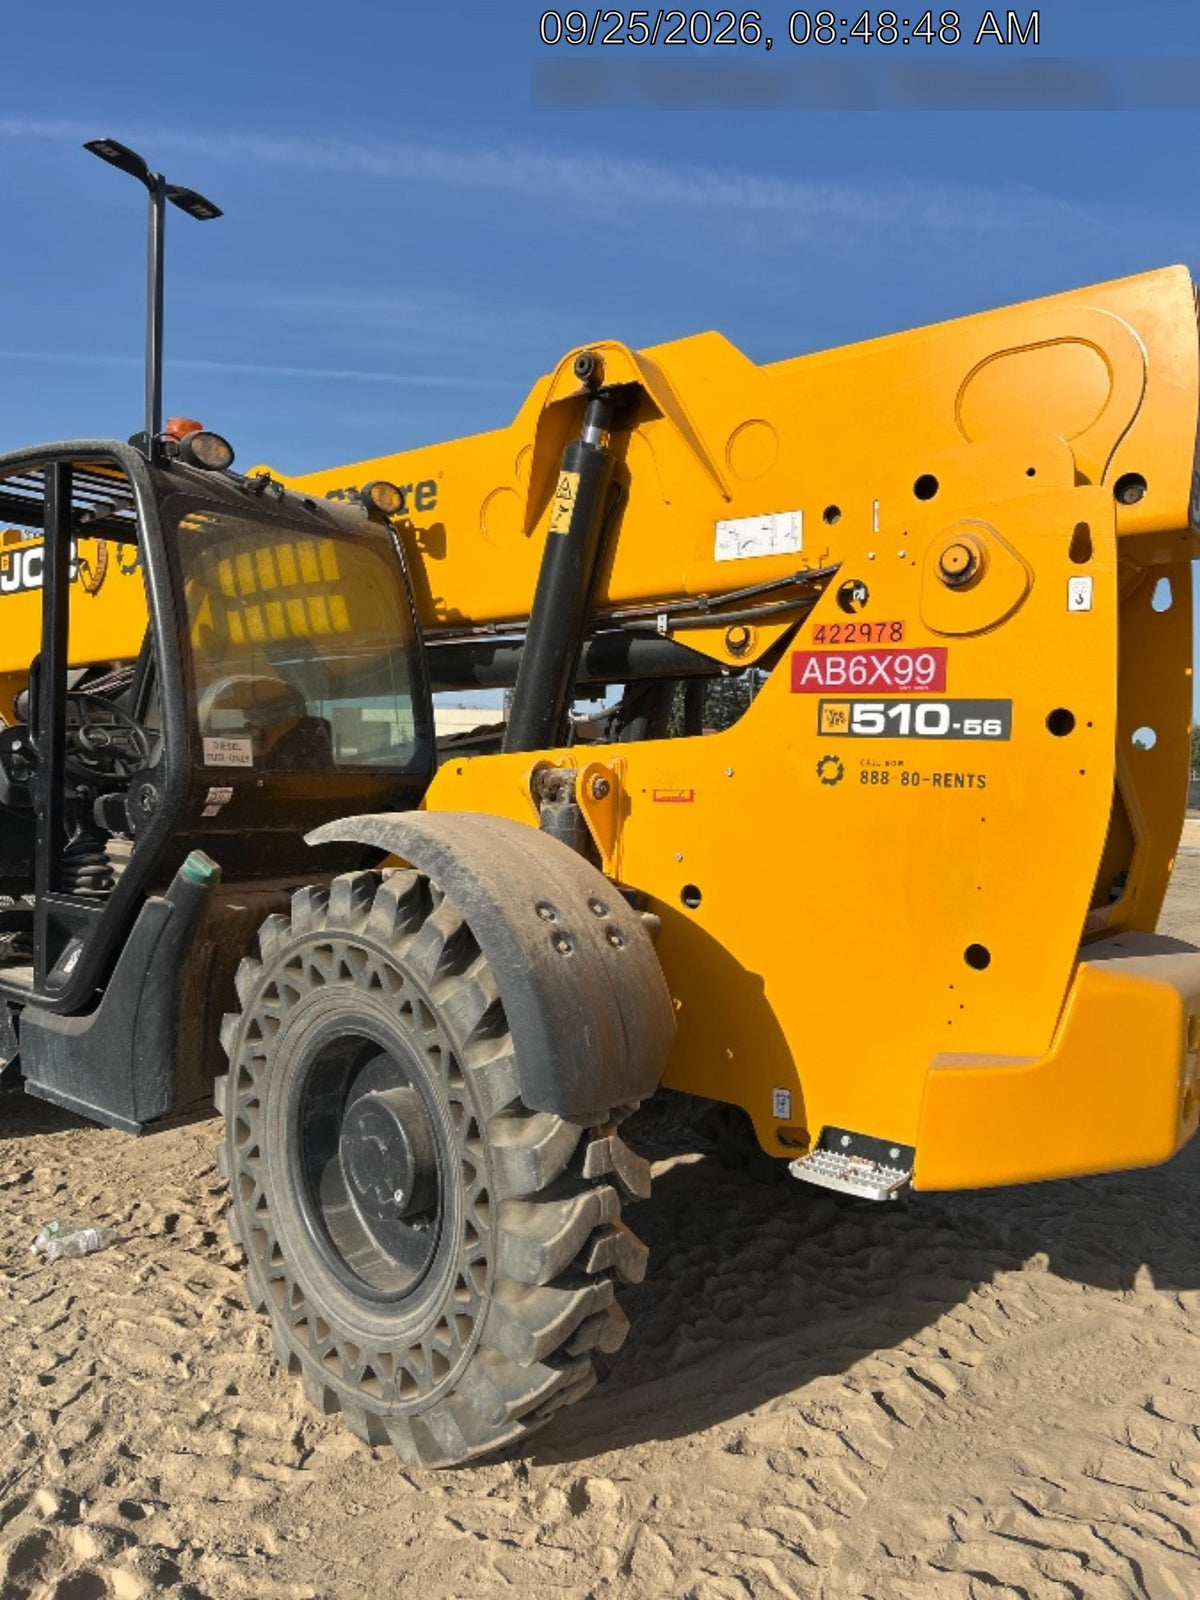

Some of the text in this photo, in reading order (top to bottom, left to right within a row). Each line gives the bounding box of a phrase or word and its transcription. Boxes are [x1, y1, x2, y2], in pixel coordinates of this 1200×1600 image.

[814, 621, 903, 644] 422978
[800, 653, 936, 686] AB6X99
[851, 703, 1003, 735] 510-56
